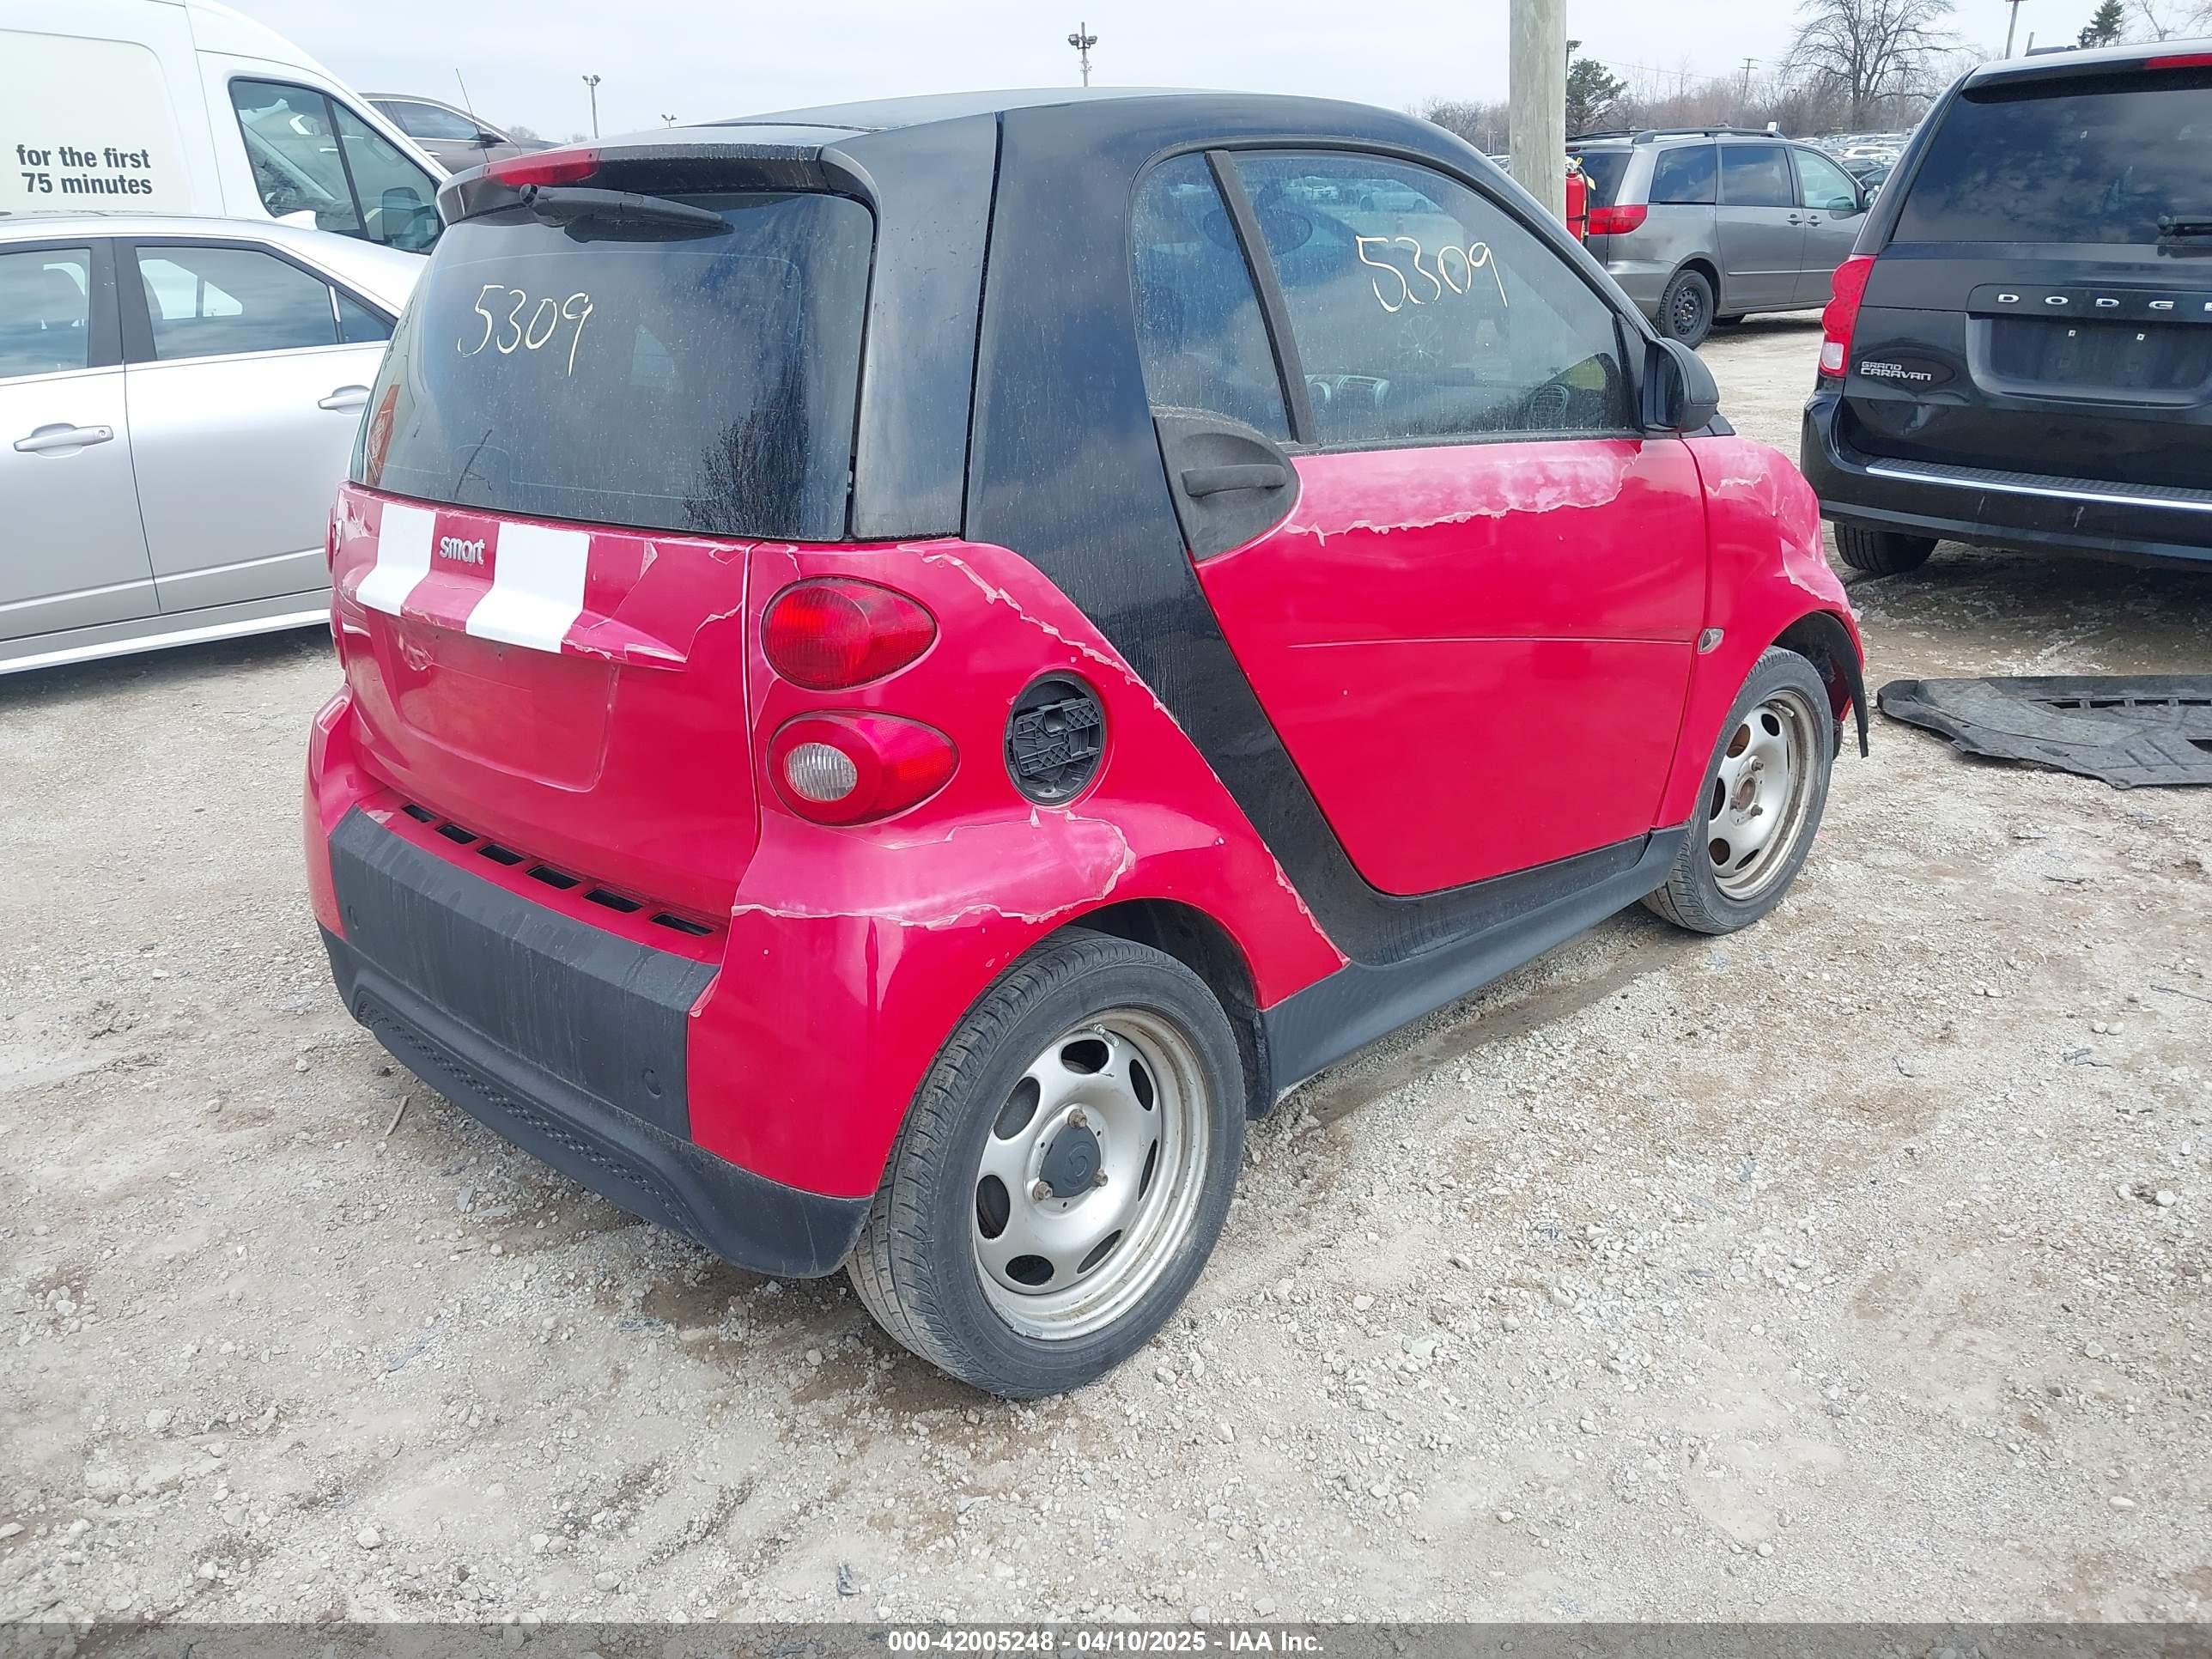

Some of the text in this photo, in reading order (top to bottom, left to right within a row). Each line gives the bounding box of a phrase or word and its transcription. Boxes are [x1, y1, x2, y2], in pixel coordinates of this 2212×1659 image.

[16, 143, 151, 168] for the first
[21, 172, 153, 195] 75 minutes
[1355, 234, 1509, 313] 5309
[457, 284, 593, 377] 5309
[1860, 368, 1932, 381] CARAVAN
[1861, 361, 1902, 371] GRAND
[440, 536, 485, 565] smart
